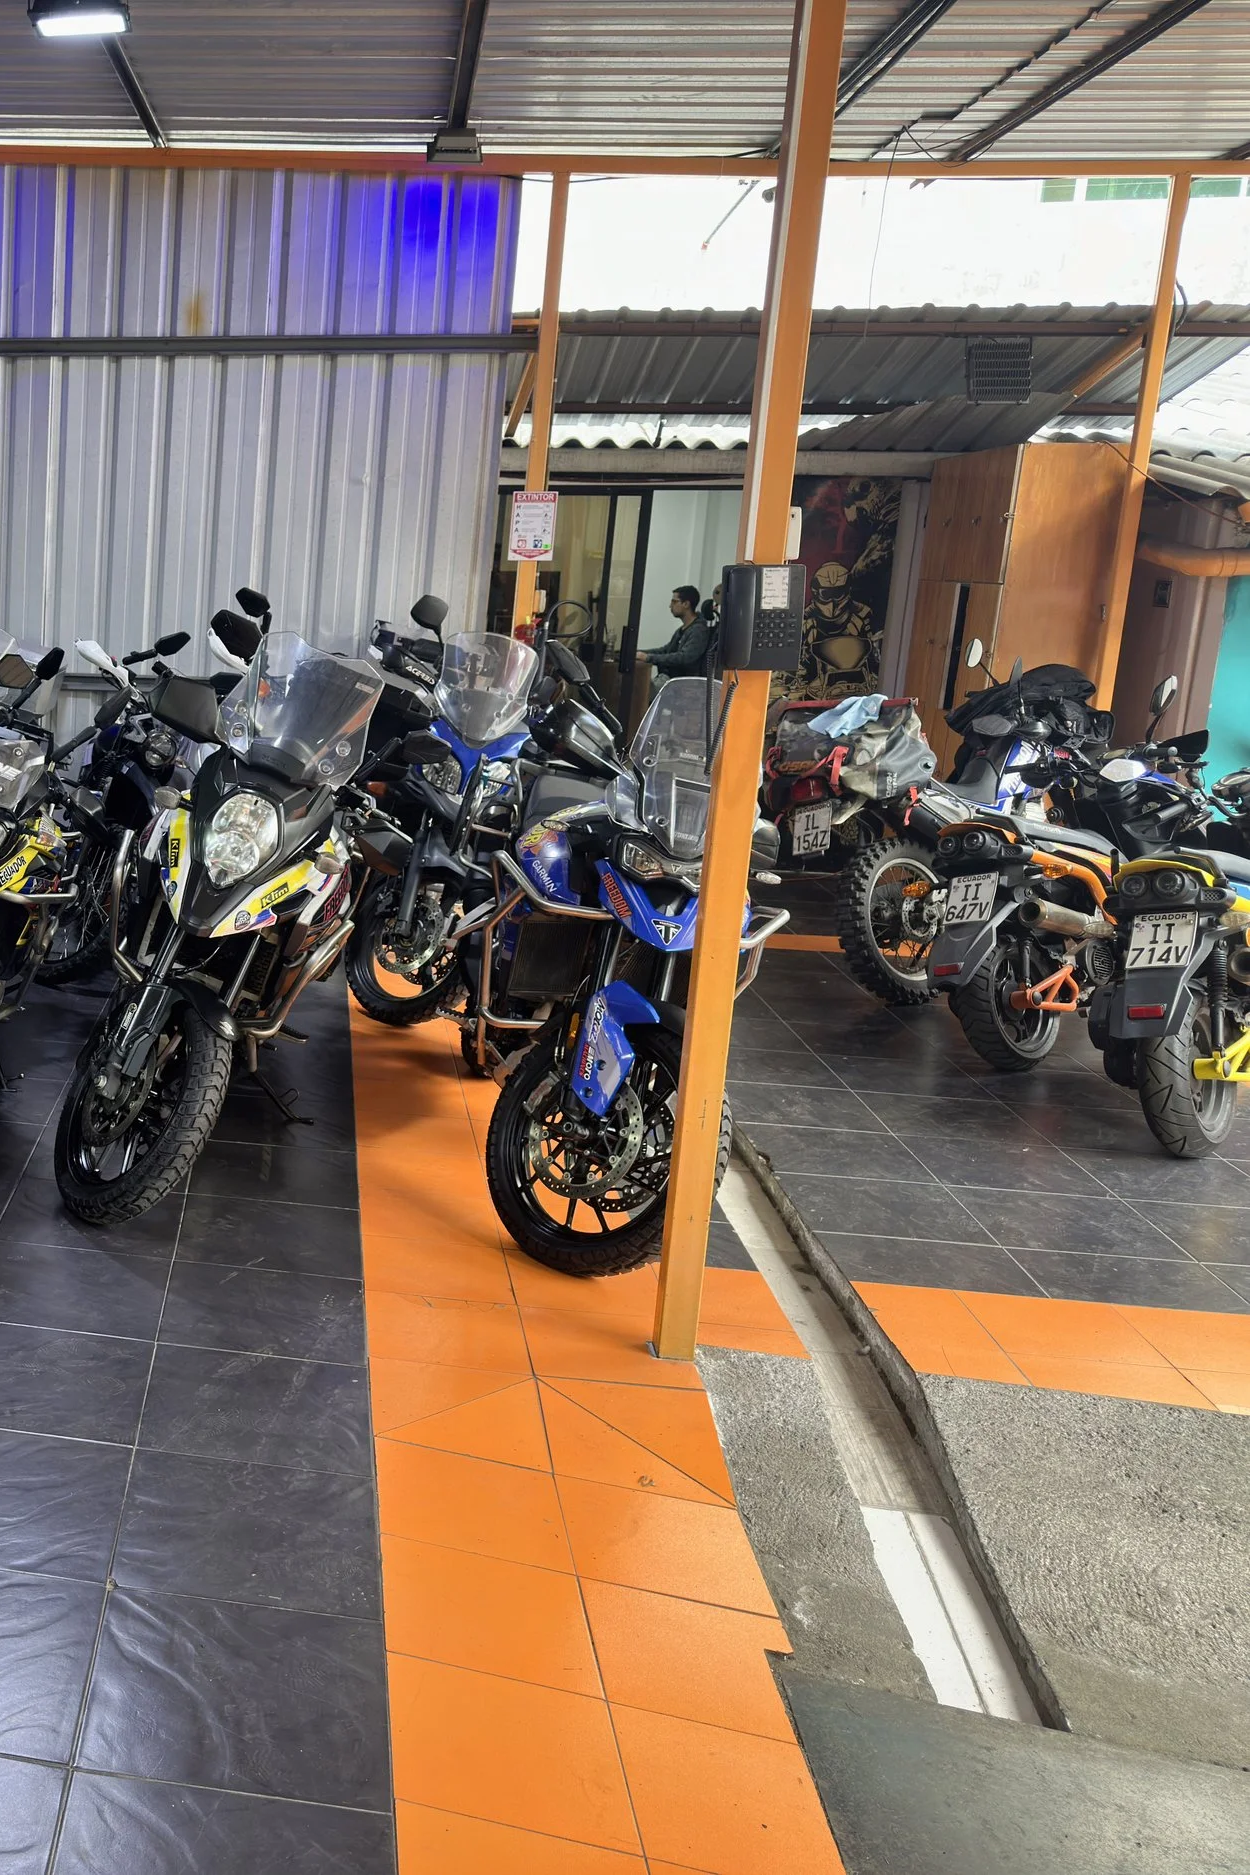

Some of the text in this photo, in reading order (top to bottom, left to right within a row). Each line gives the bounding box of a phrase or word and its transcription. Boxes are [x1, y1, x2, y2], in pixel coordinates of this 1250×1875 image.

[517, 493, 555, 501] EXTINTOR
[405, 664, 436, 685] ACERBIS
[804, 813, 819, 832] IL
[795, 830, 828, 852] 154Z
[170, 839, 180, 868] Klim
[532, 860, 558, 894] GARMIN
[957, 873, 992, 884] ECUADOR
[261, 884, 289, 908] Klim
[602, 872, 632, 919] FREEDOM
[961, 883, 981, 902] II
[945, 901, 989, 923] 647V
[1141, 913, 1188, 922] ECUADOR
[1149, 923, 1176, 944] II
[1129, 945, 1188, 967] 714V
